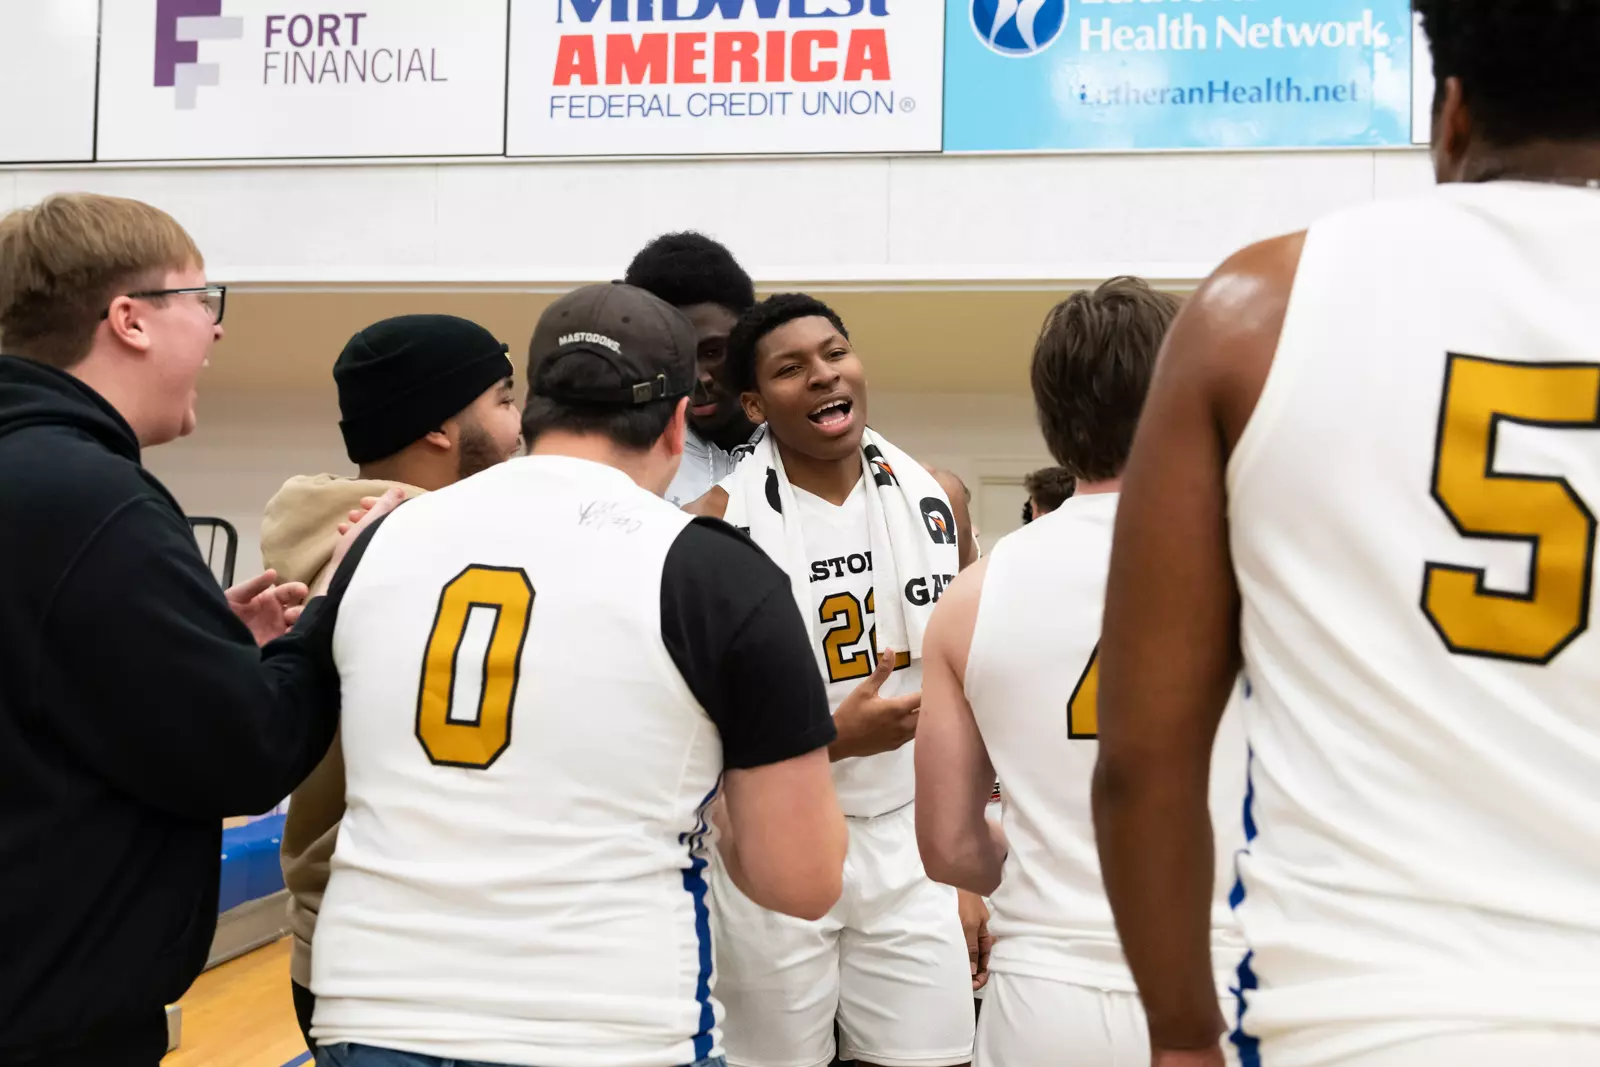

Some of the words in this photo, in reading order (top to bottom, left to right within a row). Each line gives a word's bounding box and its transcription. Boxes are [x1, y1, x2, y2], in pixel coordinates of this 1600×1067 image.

[264, 13, 367, 48] FORT
[1079, 13, 1208, 52] Health
[1215, 9, 1390, 50] Network
[263, 48, 448, 85] FINANCIAL
[552, 29, 892, 86] AMERICA
[550, 94, 681, 119] FEDERAL
[687, 92, 793, 117] CREDIT
[1419, 351, 1600, 666] 5
[809, 551, 873, 583] STO
[414, 563, 536, 770] 0
